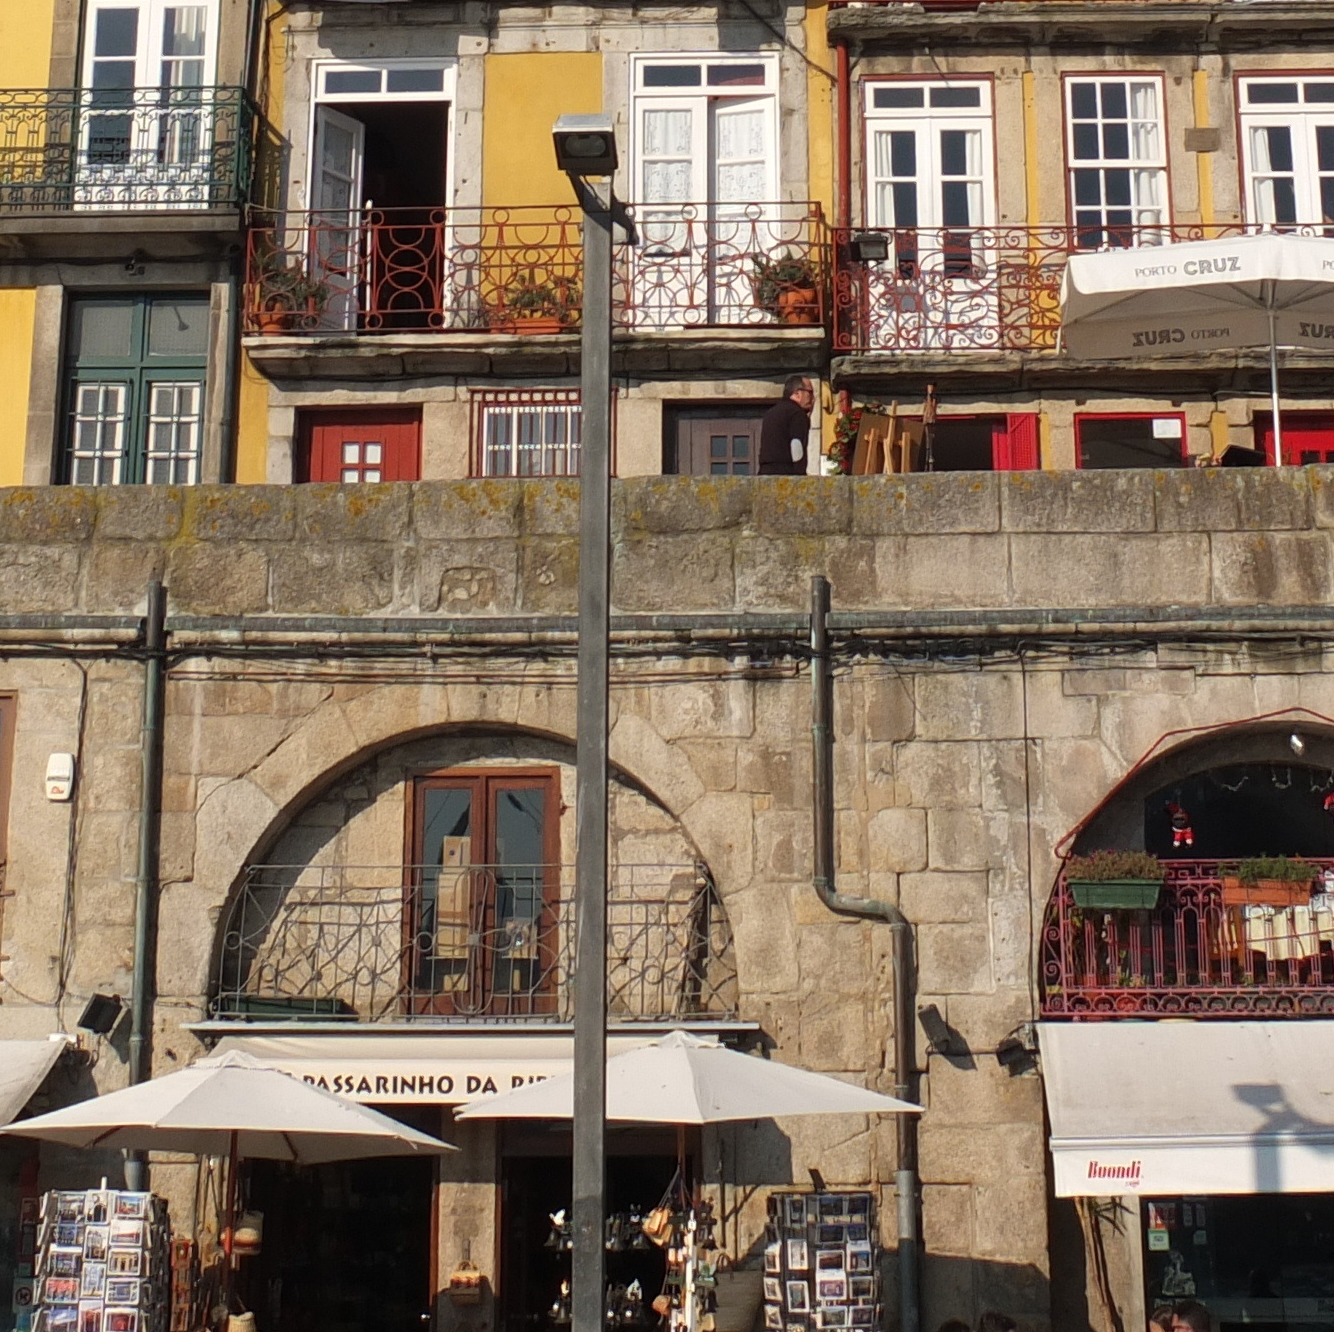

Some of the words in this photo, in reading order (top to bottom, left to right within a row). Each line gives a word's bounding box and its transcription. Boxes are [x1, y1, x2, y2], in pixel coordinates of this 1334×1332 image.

[1135, 265, 1177, 277] PORTO
[1183, 256, 1241, 276] CRUZ
[467, 1076, 498, 1094] DA
[1088, 1160, 1142, 1179] Buondi
